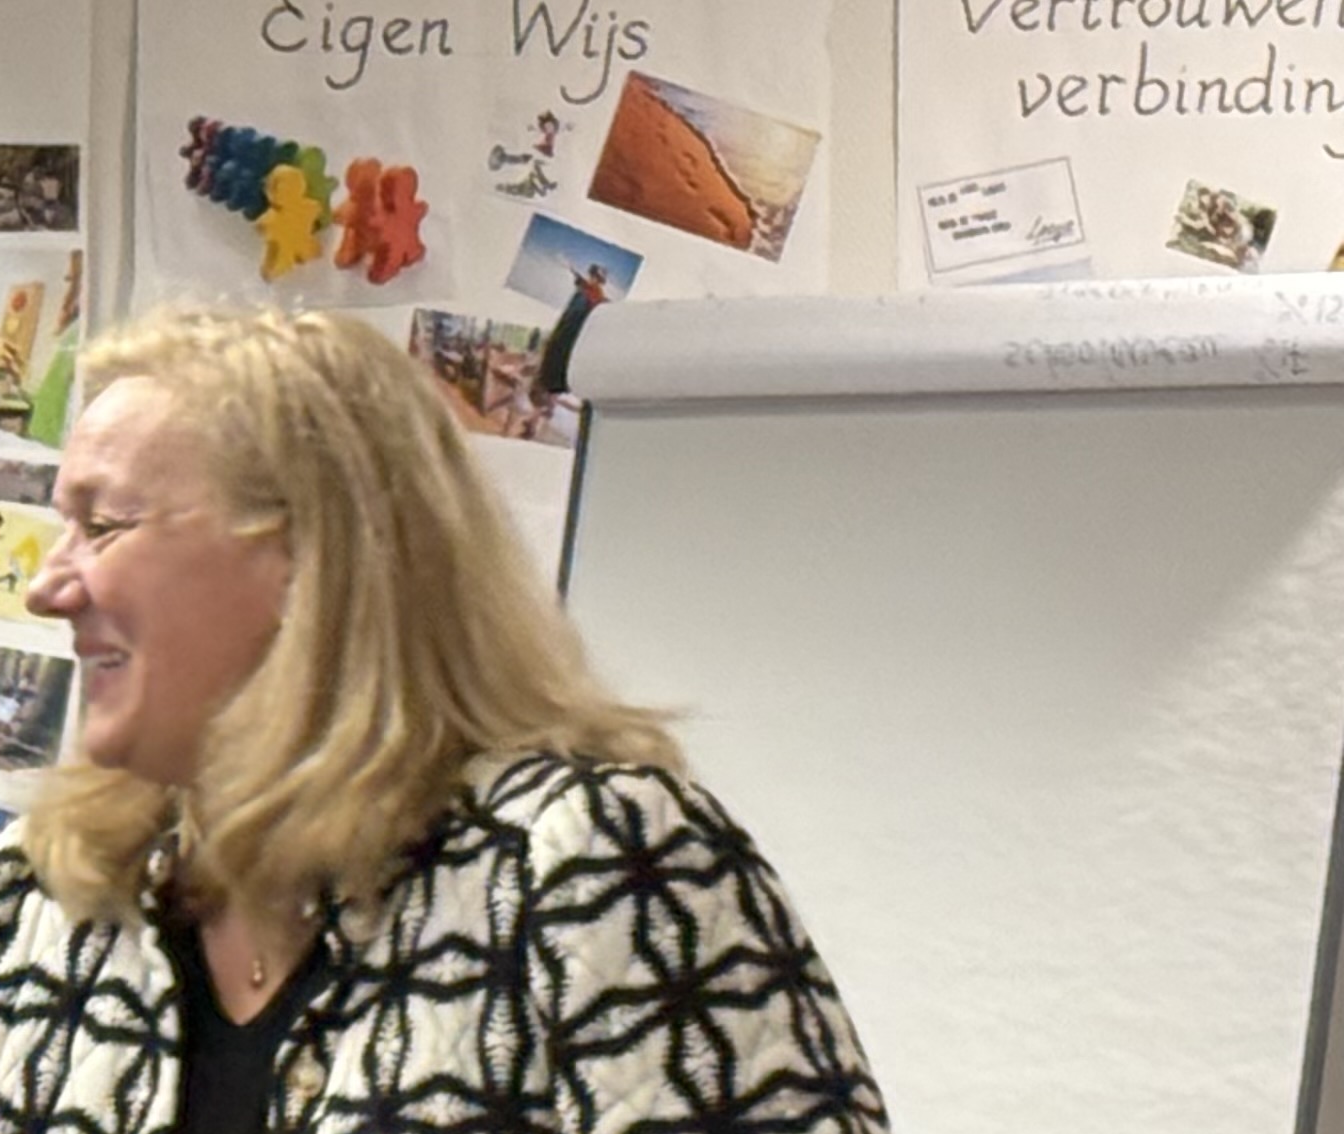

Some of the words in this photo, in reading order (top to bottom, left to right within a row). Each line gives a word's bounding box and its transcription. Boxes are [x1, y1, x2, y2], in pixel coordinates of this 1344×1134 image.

[260, 0, 453, 90] Eigen
[512, 0, 650, 105] Wijs
[1017, 40, 1344, 159] verbindin
